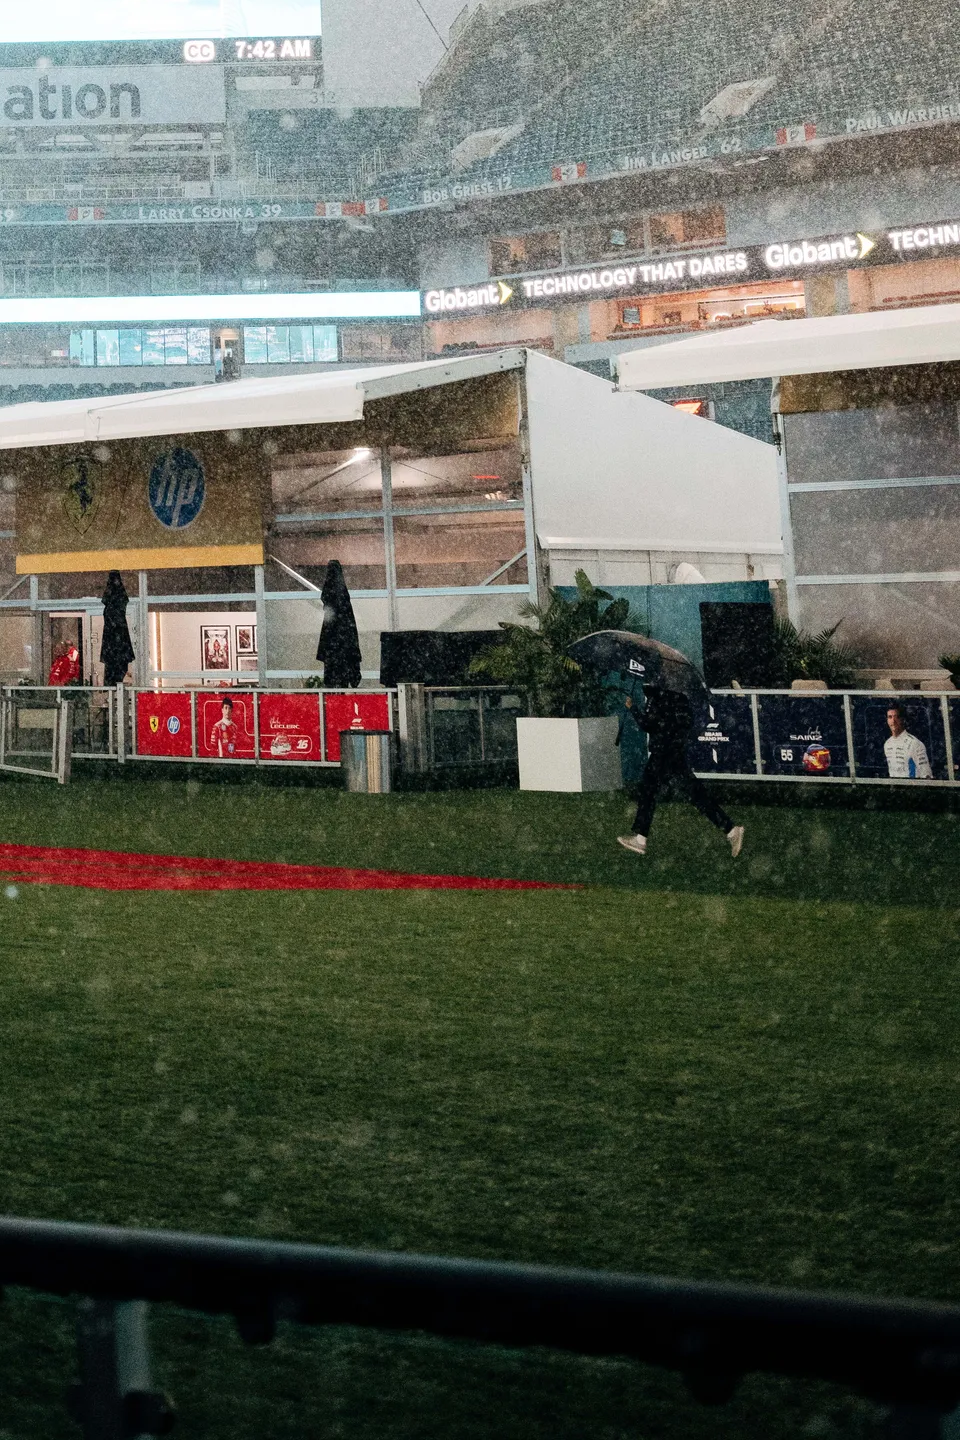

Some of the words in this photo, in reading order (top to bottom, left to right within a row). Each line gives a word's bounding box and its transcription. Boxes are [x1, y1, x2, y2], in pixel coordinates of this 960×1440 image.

[189, 45, 211, 58] CC
[235, 41, 276, 59] 7:42
[280, 40, 311, 58] AM
[310, 90, 336, 105] 312
[720, 138, 742, 154] 62
[497, 176, 513, 192] 12
[260, 203, 282, 219] 39
[888, 224, 960, 250] TECHN
[765, 236, 858, 269] Globant
[522, 267, 638, 299] TECHNOLOGY
[640, 260, 686, 283] THAT
[688, 253, 748, 277] DARES
[425, 284, 500, 312] Globant
[296, 739, 309, 750] 16
[780, 748, 794, 762] 55
